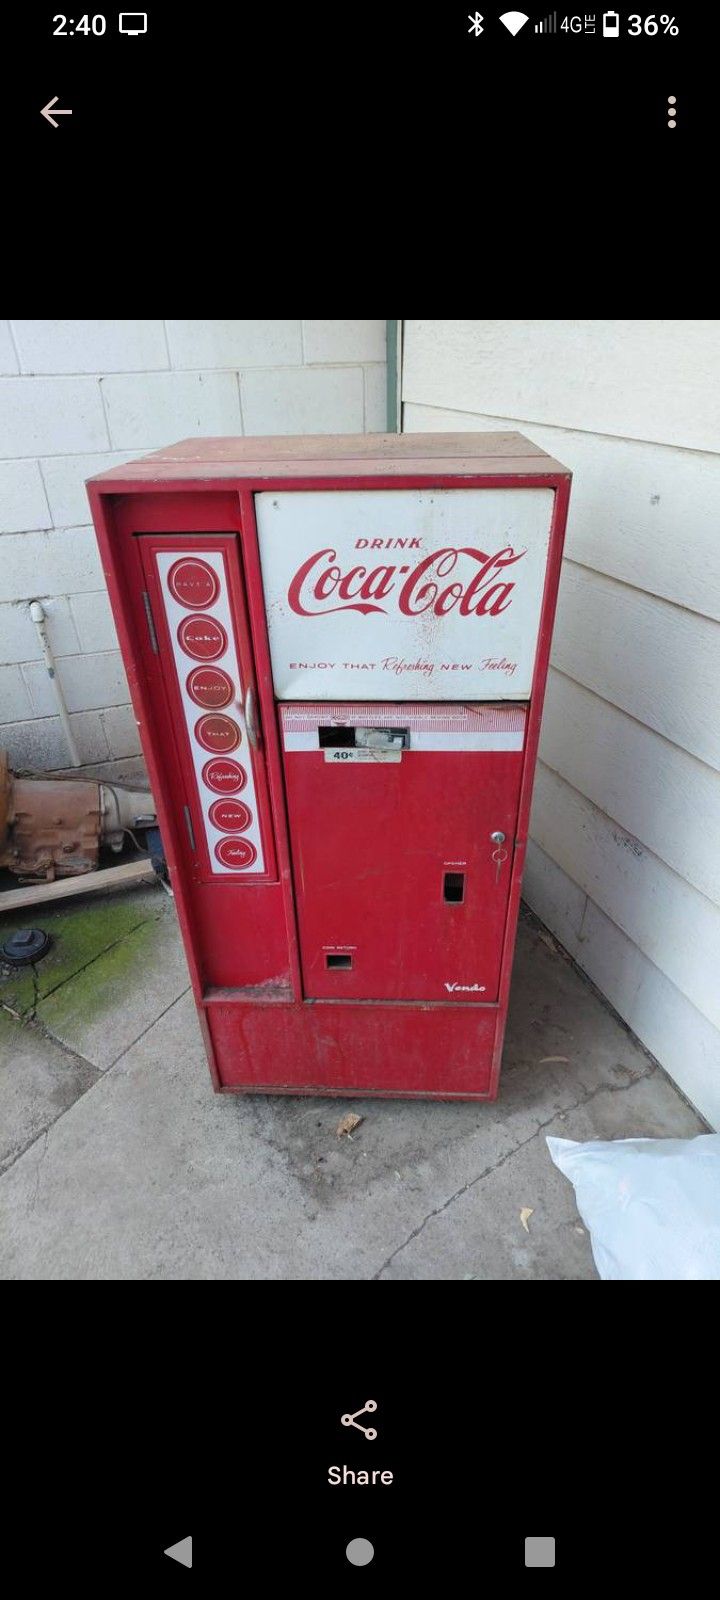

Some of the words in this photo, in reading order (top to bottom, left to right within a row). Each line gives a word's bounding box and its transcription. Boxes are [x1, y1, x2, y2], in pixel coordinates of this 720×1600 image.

[354, 537, 423, 549] DRINK
[288, 547, 528, 617] Coca-Cola
[289, 662, 336, 670] ENJOY
[342, 662, 377, 670] THAT
[381, 656, 435, 676] Refreshing
[440, 663, 473, 671] NEW
[477, 658, 518, 676] Feeling
[210, 772, 239, 782] Refreshing
[444, 981, 487, 993] Vendo
